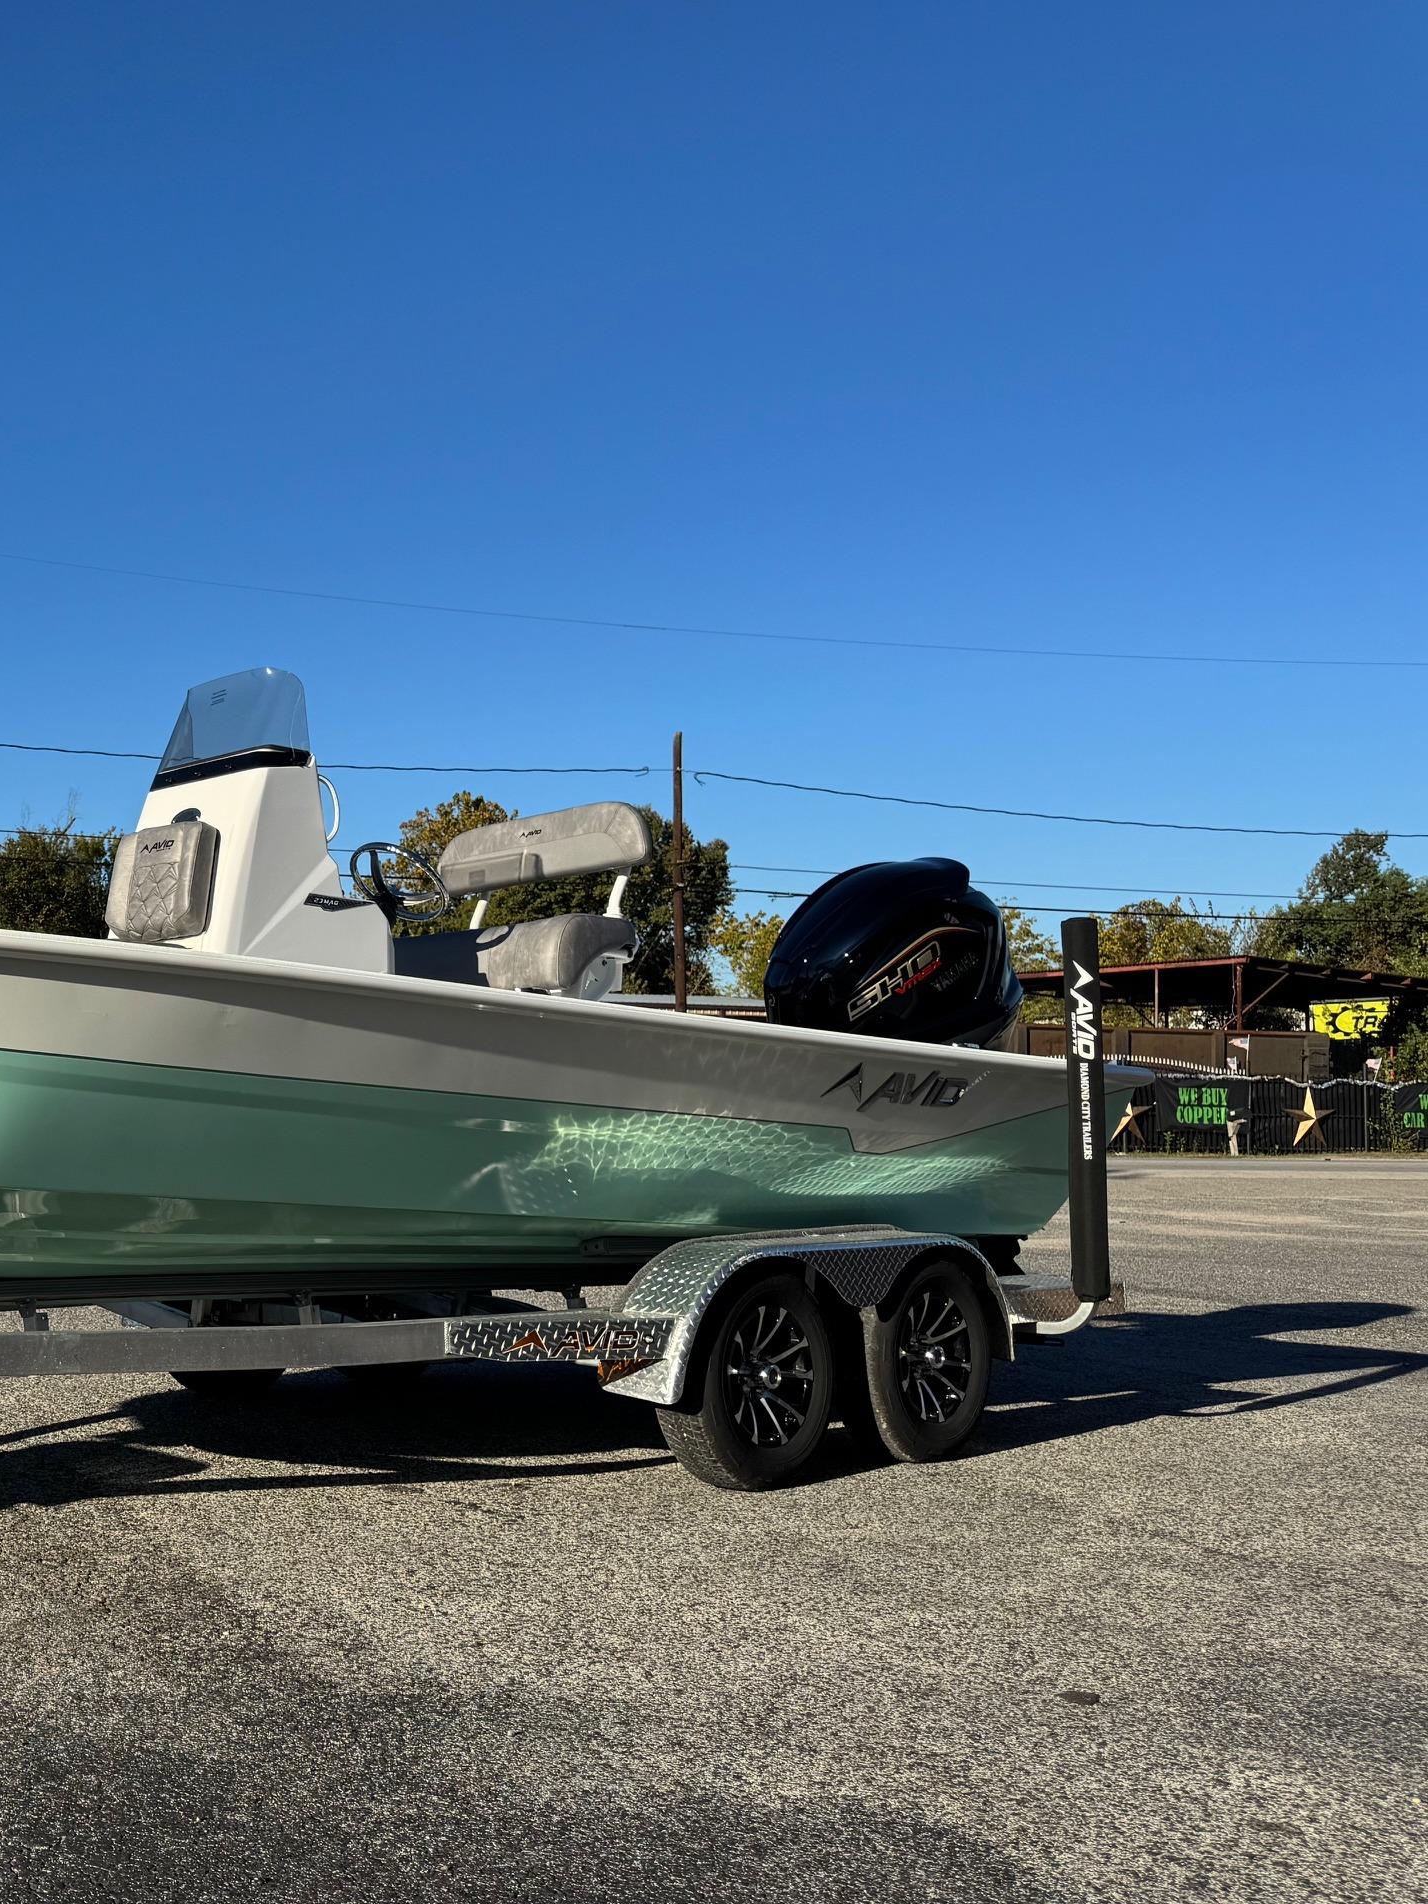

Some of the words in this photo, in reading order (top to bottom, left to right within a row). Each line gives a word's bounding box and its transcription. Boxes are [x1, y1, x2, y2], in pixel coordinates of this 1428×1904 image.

[148, 839, 175, 854] AVID
[1070, 987, 1098, 1060] AVID
[856, 1069, 969, 1112] AVID
[1079, 1062, 1091, 1101] DIAMOND
[1178, 1087, 1198, 1105] WE
[1201, 1087, 1228, 1106] BUY
[1081, 1101, 1091, 1121] CITY
[1403, 1111, 1425, 1128] CAR
[1082, 1120, 1093, 1160] TRAILERS
[550, 1327, 641, 1359] AVID
